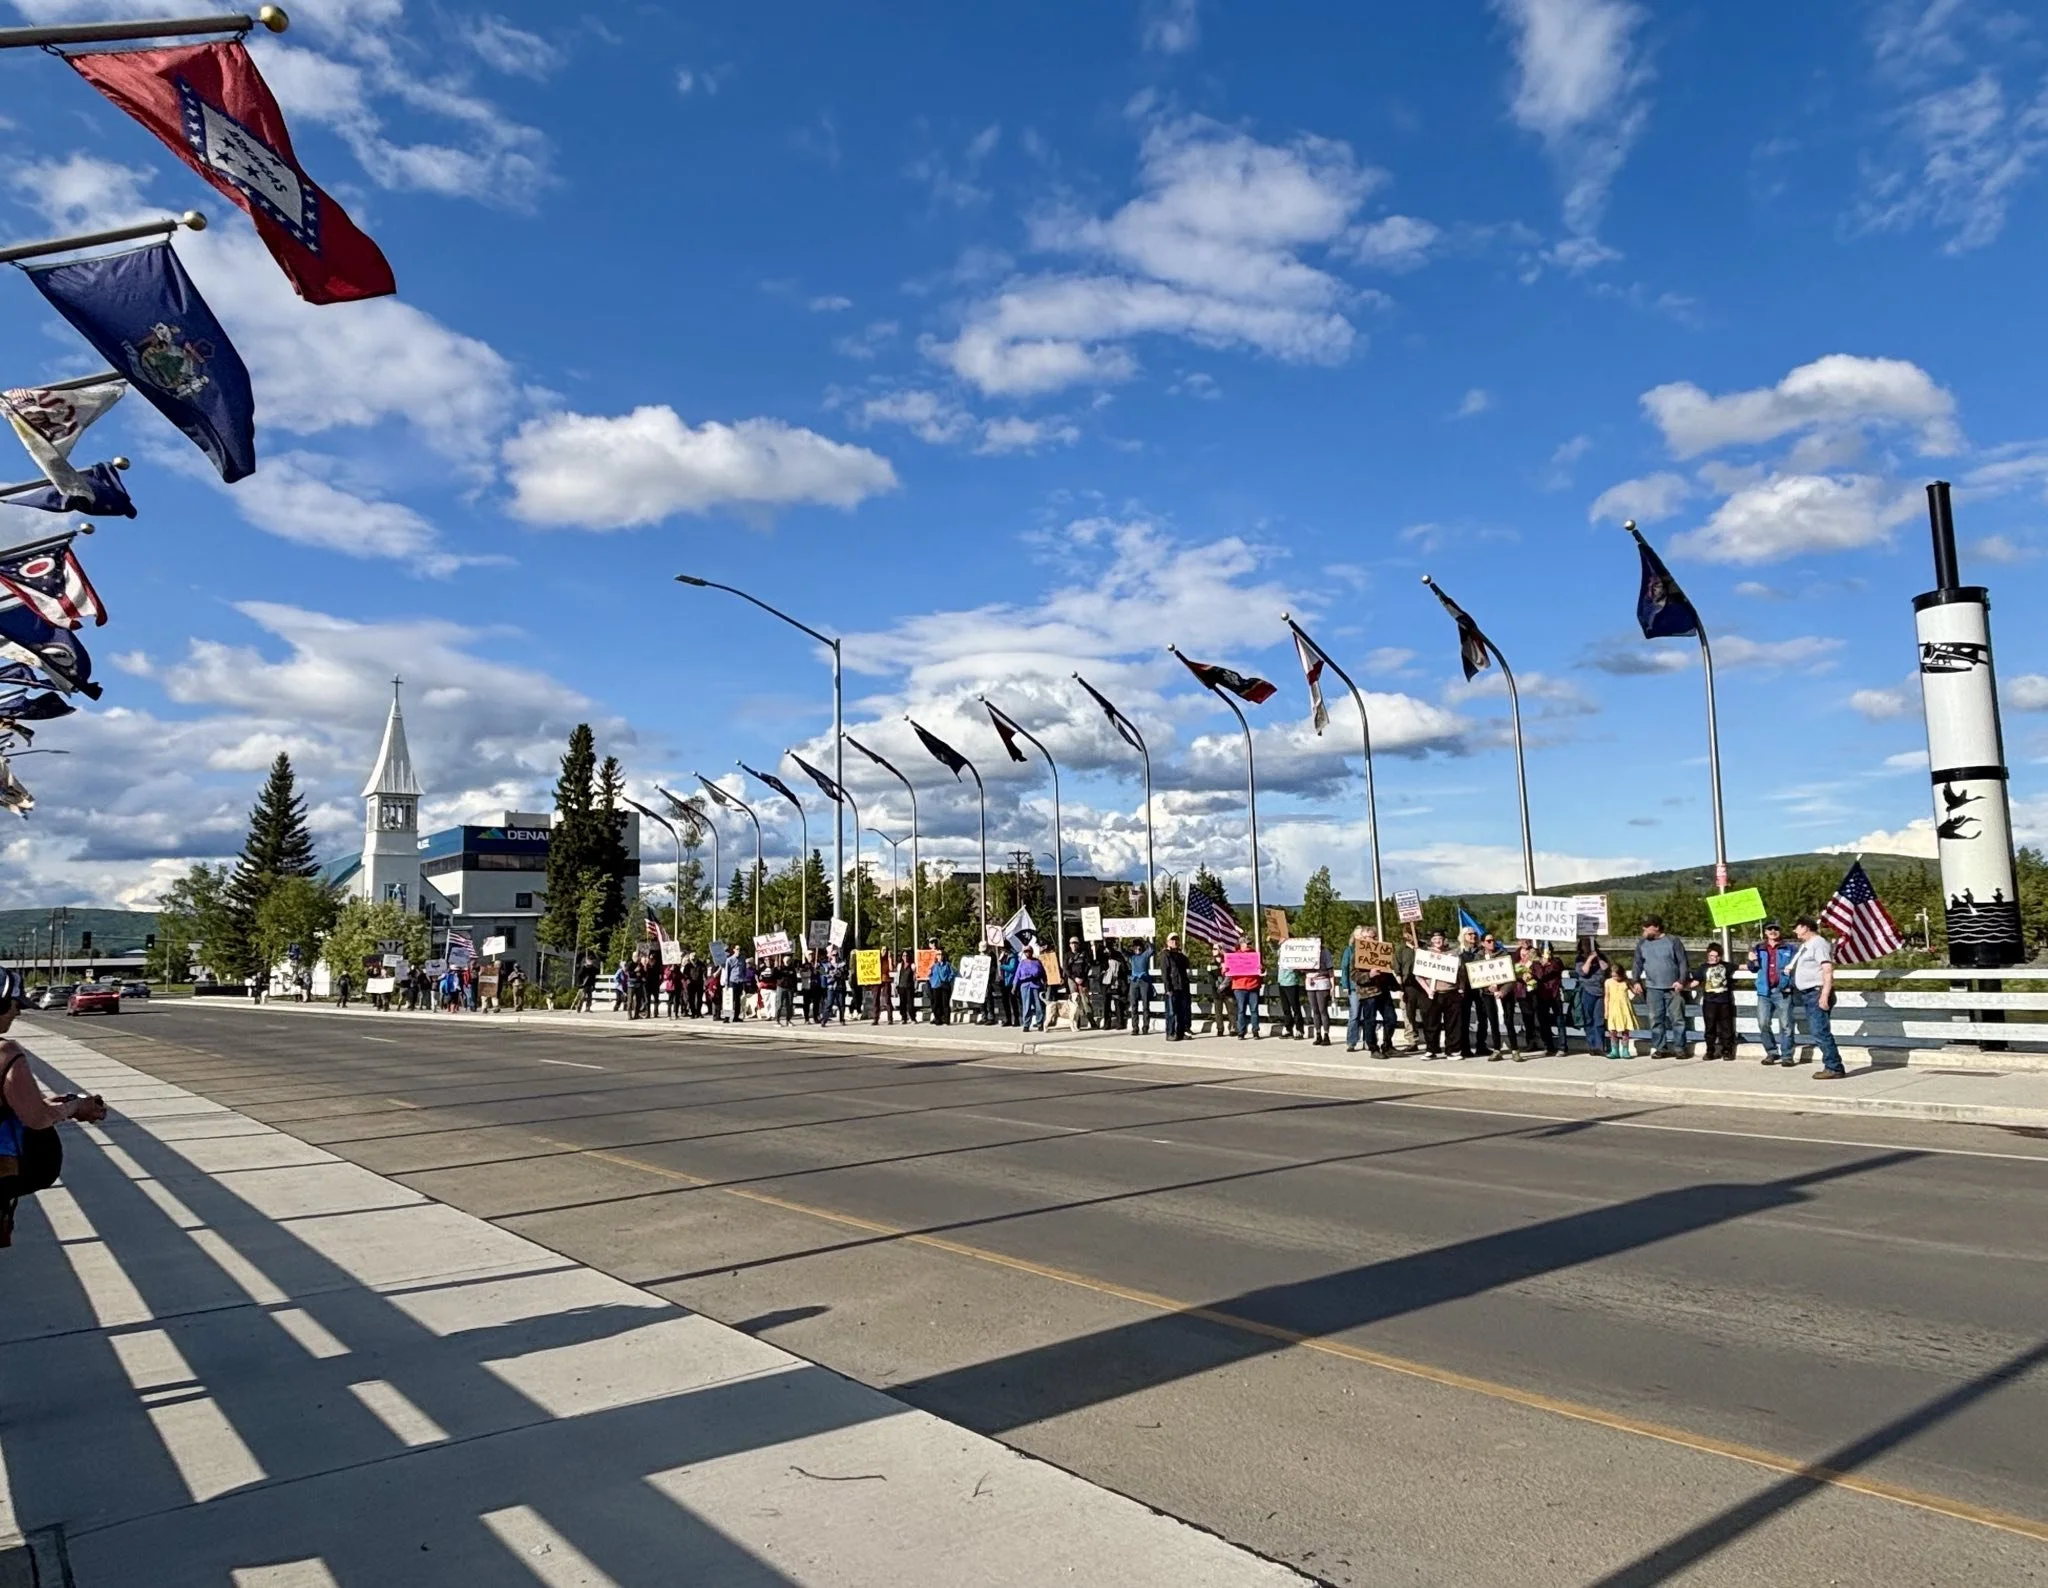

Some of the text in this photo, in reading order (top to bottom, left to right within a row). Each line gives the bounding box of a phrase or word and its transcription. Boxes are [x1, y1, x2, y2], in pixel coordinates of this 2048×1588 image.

[226, 128, 287, 193] ARKANSAS
[1526, 900, 1568, 911] UNITE
[1519, 911, 1576, 924] AGAINST
[1518, 924, 1576, 937] TYRRANY
[1359, 941, 1392, 955] SAY NO
[1358, 956, 1392, 967] FASCISM
[1416, 959, 1456, 973] DICTATORS
